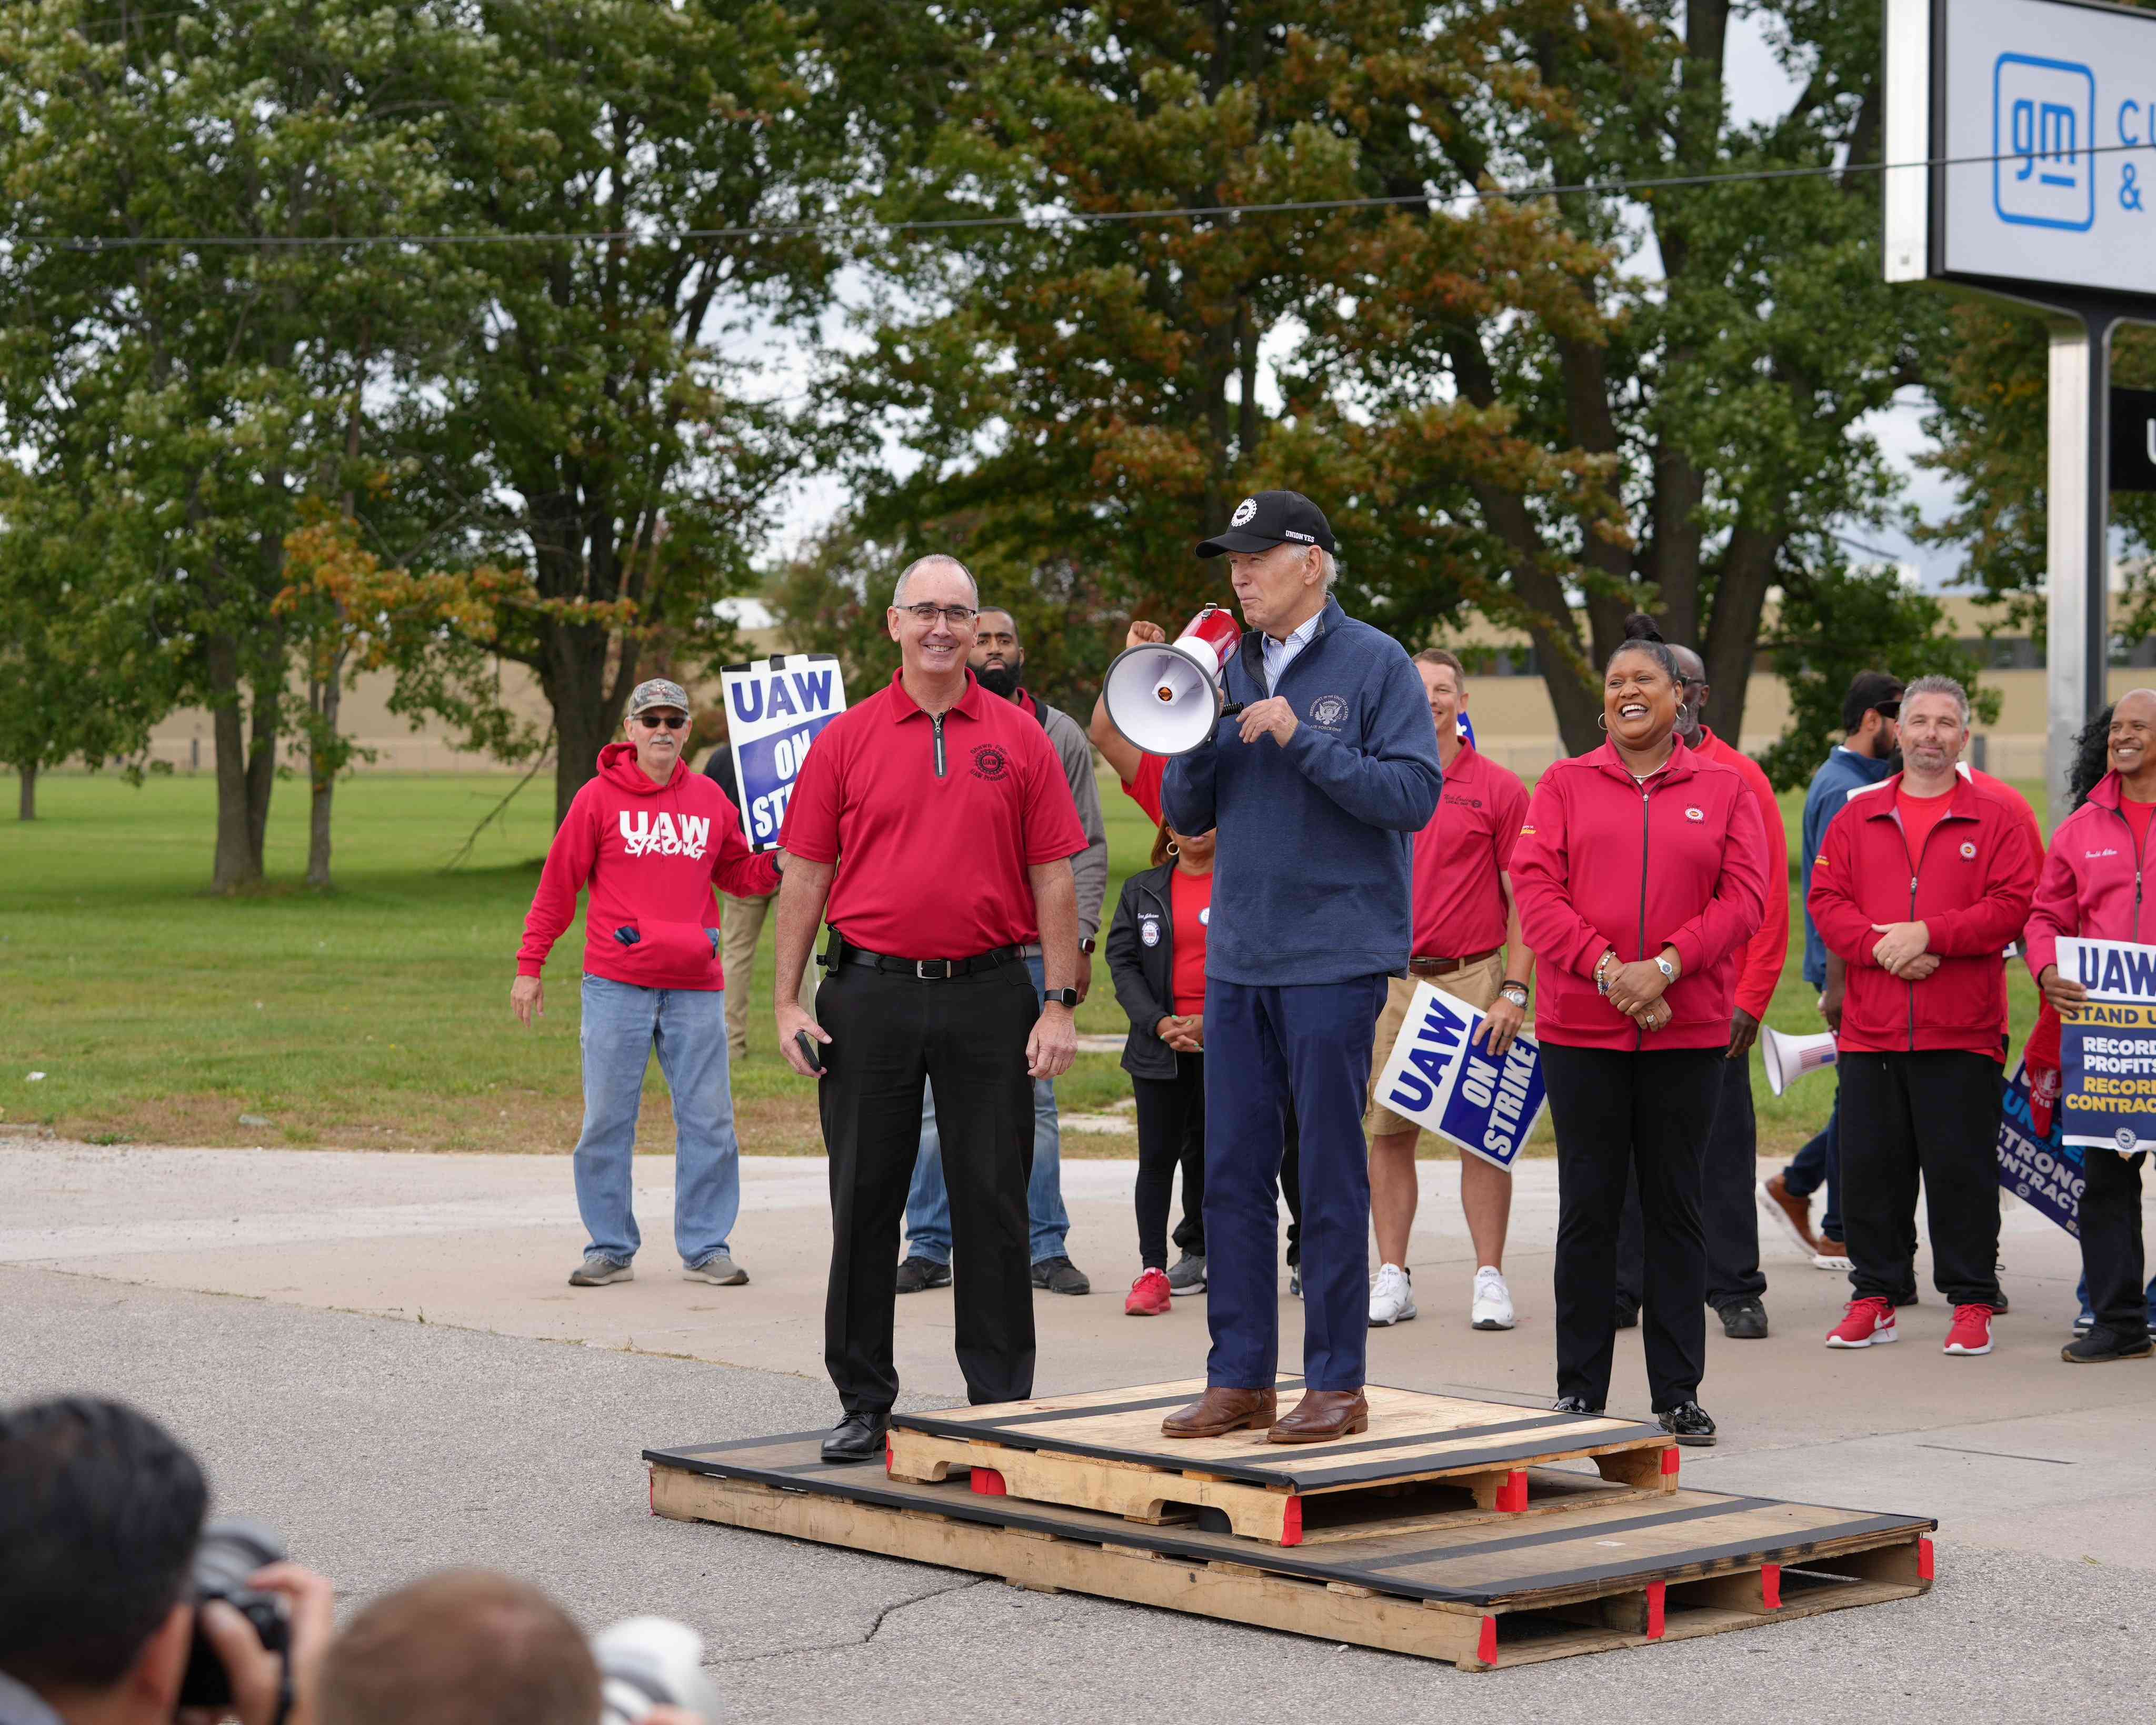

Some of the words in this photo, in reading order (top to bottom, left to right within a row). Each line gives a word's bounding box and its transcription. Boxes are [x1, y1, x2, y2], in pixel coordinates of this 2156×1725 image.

[2012, 98, 2076, 182] gm
[2119, 162, 2143, 212] &
[1285, 530, 1303, 540] UNION
[1304, 534, 1314, 543] YES
[731, 670, 832, 723] UAW
[1334, 694, 1347, 705] UNITED
[774, 729, 811, 781] ON
[620, 810, 710, 848] UAW
[752, 781, 795, 838] ST
[624, 834, 706, 861] STRONG
[2078, 946, 2156, 996] UAW
[1389, 996, 1467, 1112] UAW
[1462, 1055, 1499, 1109] ON
[1483, 1036, 1538, 1156] STRIKE
[1996, 1145, 2079, 1218] ONTRACT
[1998, 1122, 2086, 1199] TRONG
